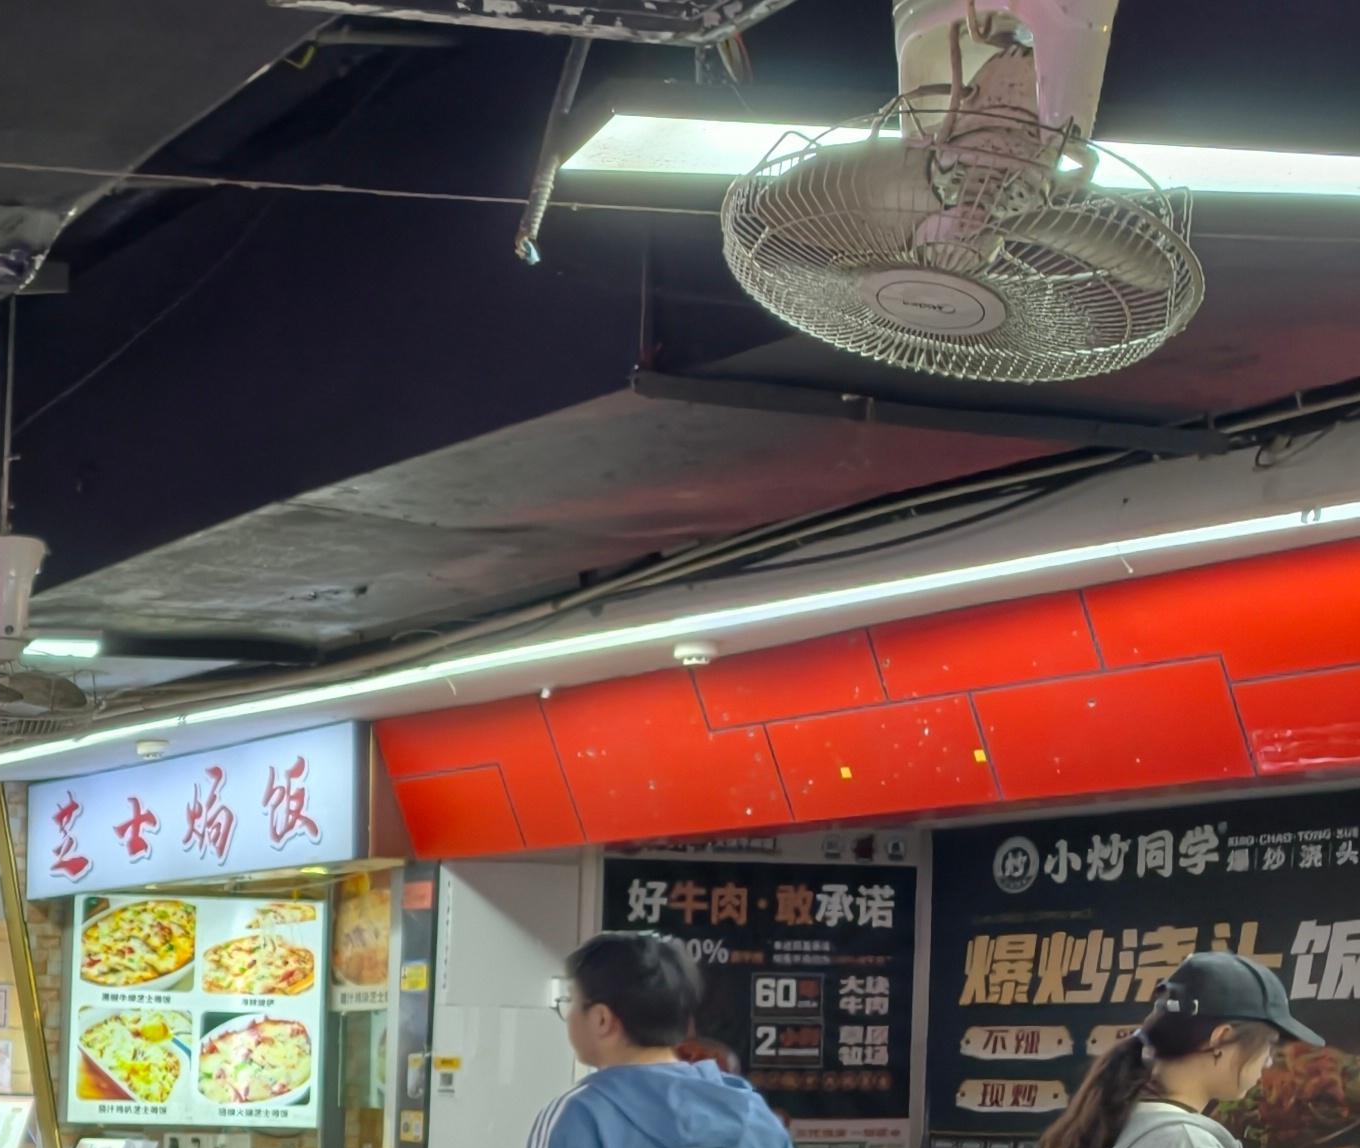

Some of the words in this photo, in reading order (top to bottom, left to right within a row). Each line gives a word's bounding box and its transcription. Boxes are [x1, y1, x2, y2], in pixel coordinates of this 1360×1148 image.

[50, 756, 320, 878] 芝士焗饭
[1043, 824, 1220, 884] 小炒同学
[755, 977, 797, 1008] 60
